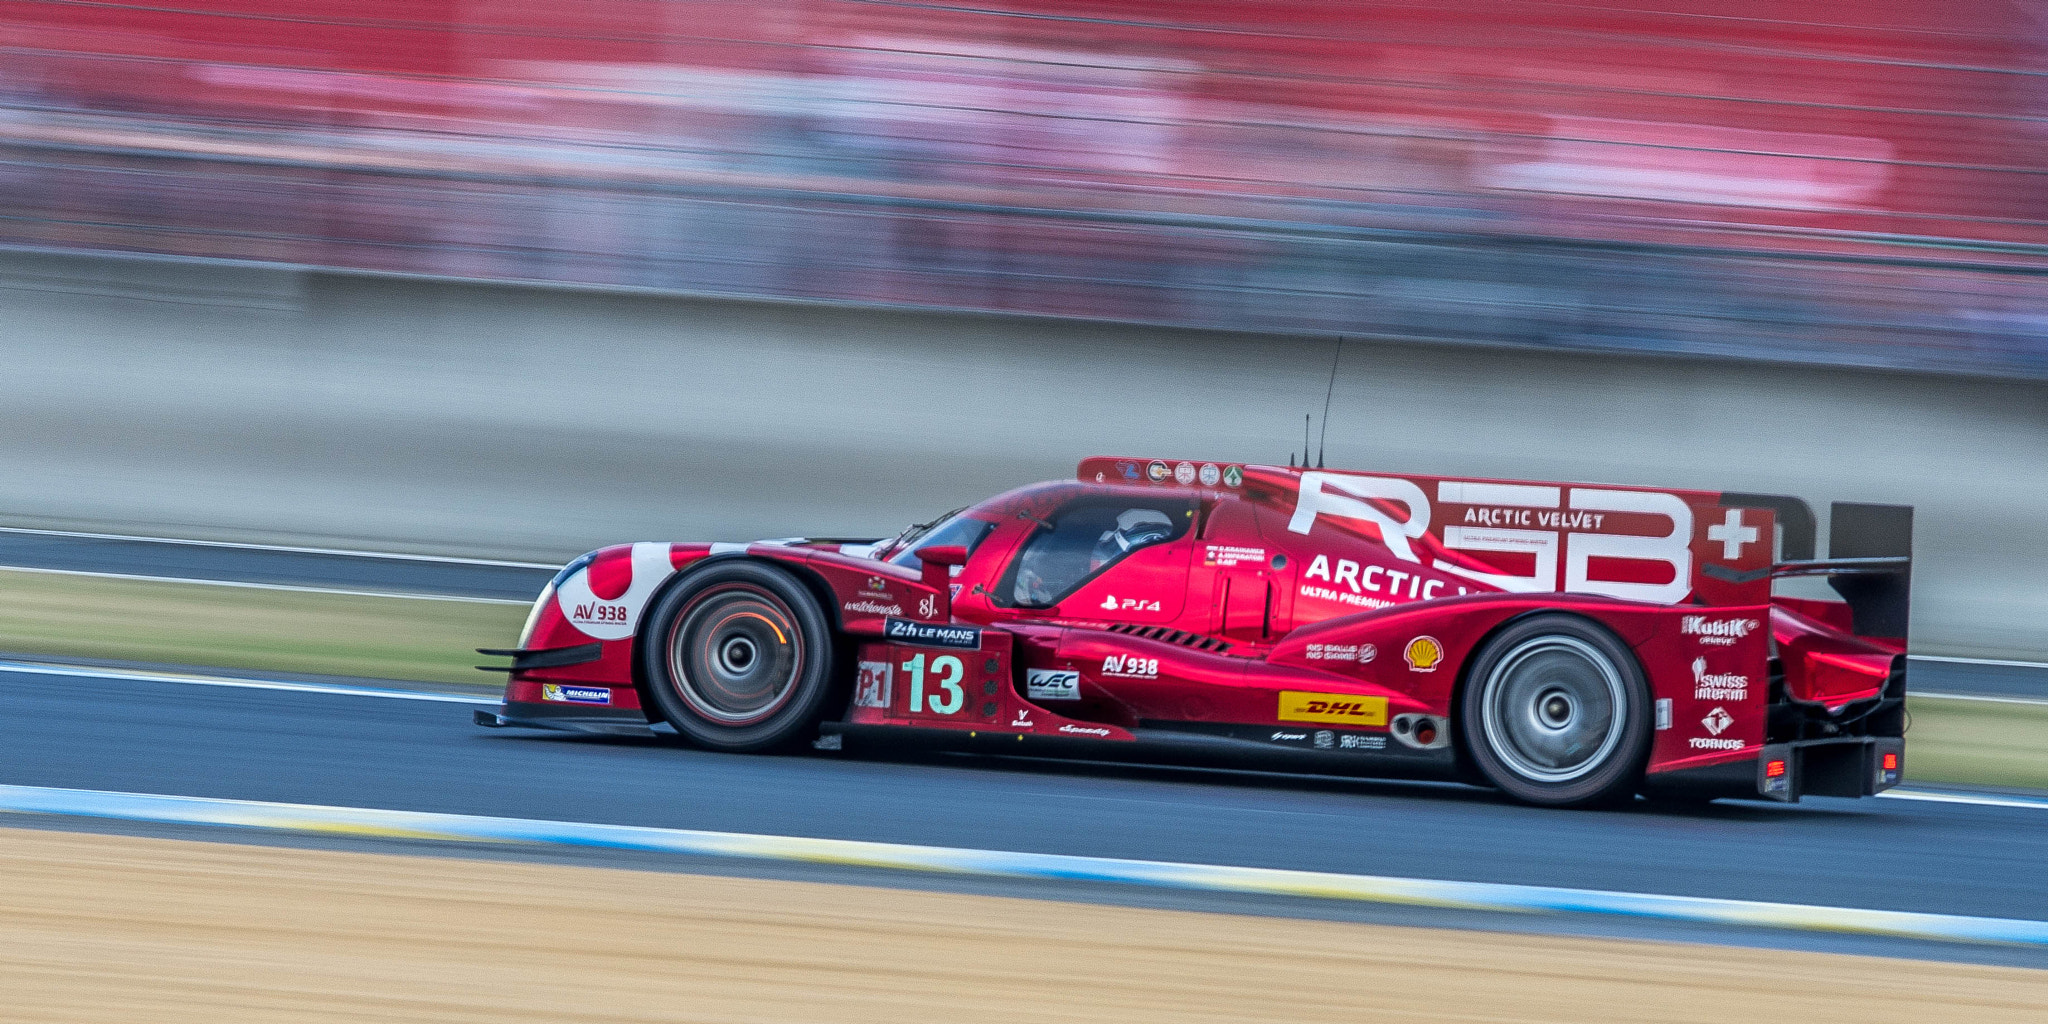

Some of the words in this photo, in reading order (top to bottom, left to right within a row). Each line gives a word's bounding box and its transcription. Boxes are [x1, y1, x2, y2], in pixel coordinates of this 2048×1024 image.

[1464, 508, 1531, 526] ARCTIC
[1538, 511, 1604, 528] VELVET
[1305, 554, 1445, 600] ARCTIC
[1301, 585, 1338, 601] ULTRA
[573, 601, 595, 620] AV
[598, 606, 627, 621] 938
[1122, 598, 1160, 611] PS4
[918, 629, 936, 638] LE
[936, 629, 974, 640] MANS
[1102, 654, 1127, 672] AV
[1127, 658, 1158, 675] 938
[902, 653, 964, 714] 13
[1030, 673, 1077, 689] WEC
[566, 689, 609, 699] MICHELIN
[1307, 701, 1366, 716] DHL
[1689, 737, 1745, 751] TORNOS
